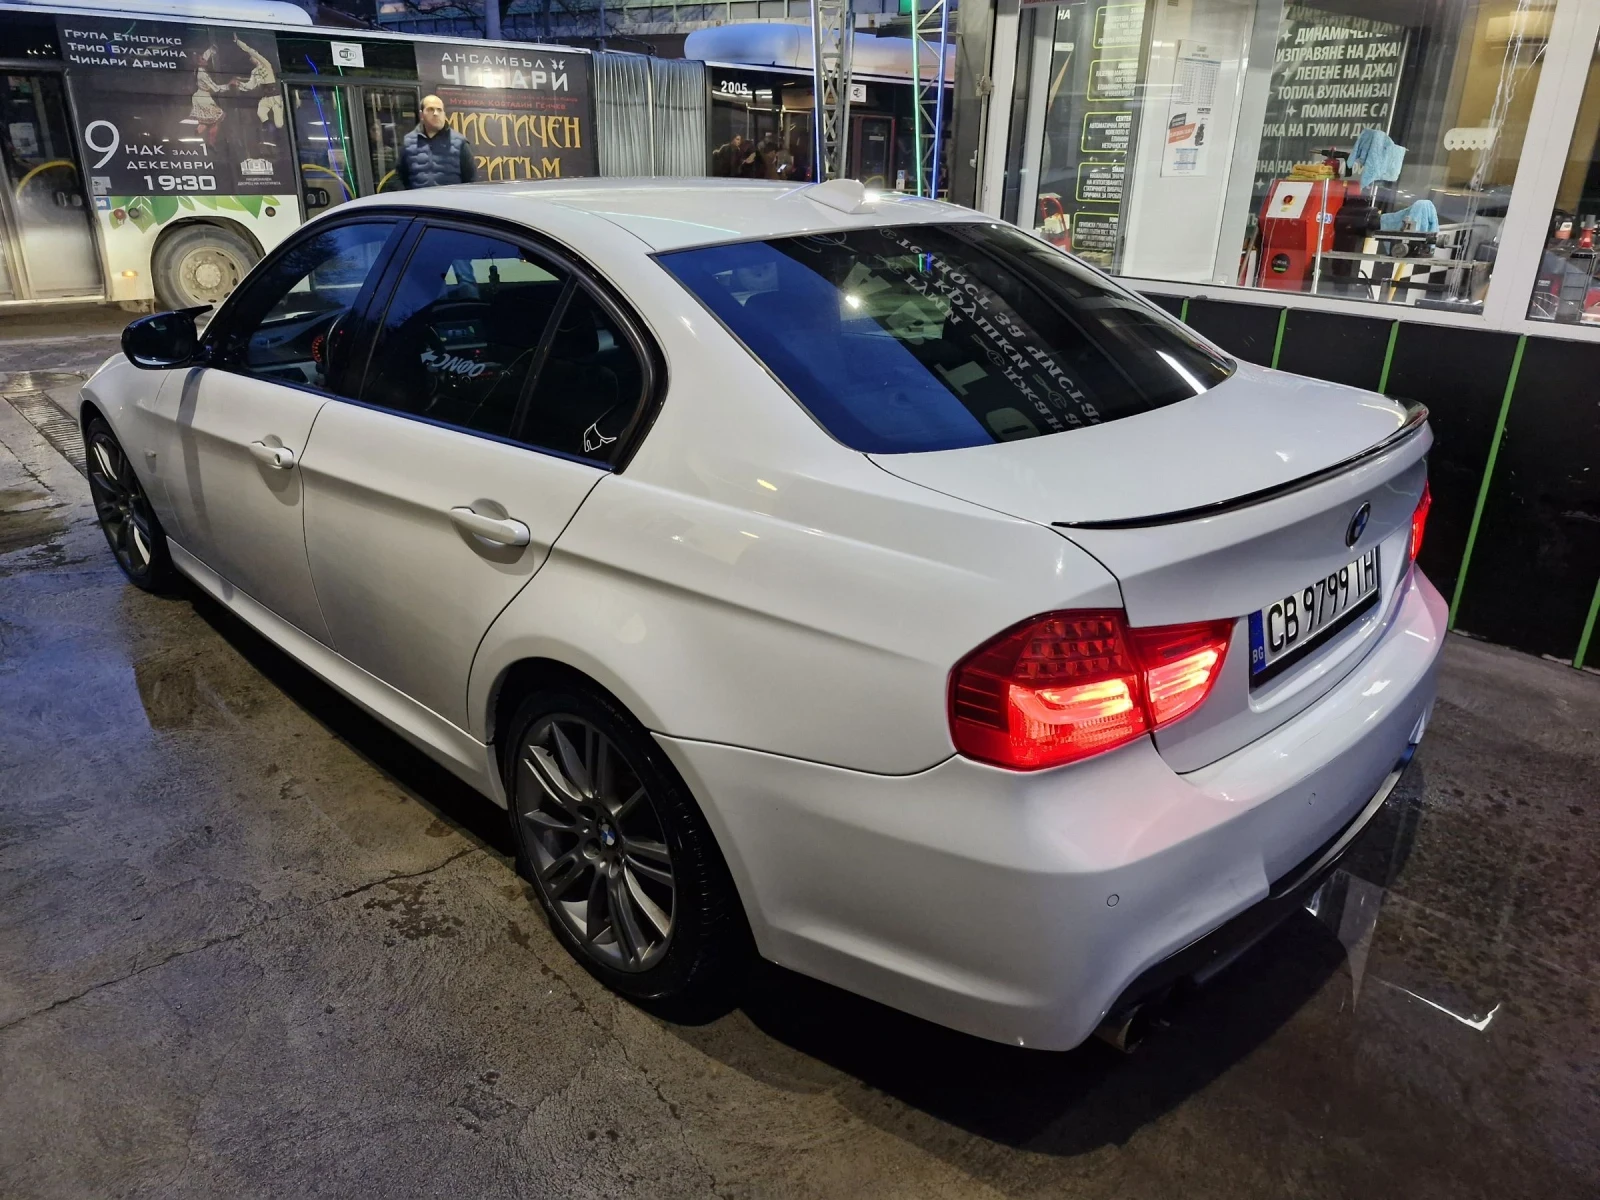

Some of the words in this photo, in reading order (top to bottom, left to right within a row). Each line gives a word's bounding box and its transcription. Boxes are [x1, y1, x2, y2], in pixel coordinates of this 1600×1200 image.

[64, 29, 108, 40] ГРУПА
[113, 32, 182, 45] ЕТНОТИКС
[67, 42, 105, 53] ТРИО
[111, 45, 187, 58] БУЛГАРИНА
[1276, 45, 1344, 62] ИЗПРАВЯНЕ
[1347, 44, 1364, 59] НА
[70, 54, 127, 66] ЧИНАРИ
[132, 59, 177, 69] ДРЪМС
[442, 52, 545, 69] АНСАМБЪЛ
[1295, 64, 1340, 80] ЛЕПЕНЕ
[1343, 64, 1359, 79] НА
[720, 80, 748, 95] 2005
[1278, 85, 1314, 100] ТОПЛА
[1301, 103, 1368, 118] ПОМПАНИЕ
[1370, 103, 1379, 117] С
[1379, 102, 1388, 117] А
[1288, 123, 1304, 137] НА
[1305, 123, 1338, 137] ГУМИ
[1341, 123, 1348, 136] И
[1350, 123, 1383, 139] ДЖА
[85, 120, 119, 169] 9
[125, 144, 165, 156] НДК
[200, 143, 208, 156] 1
[126, 161, 214, 170] ДЕКЕМВРИ
[1277, 160, 1292, 173] НА
[143, 175, 217, 191] 19:30
[1302, 564, 1349, 633] 9799
[1253, 646, 1264, 664] BG
